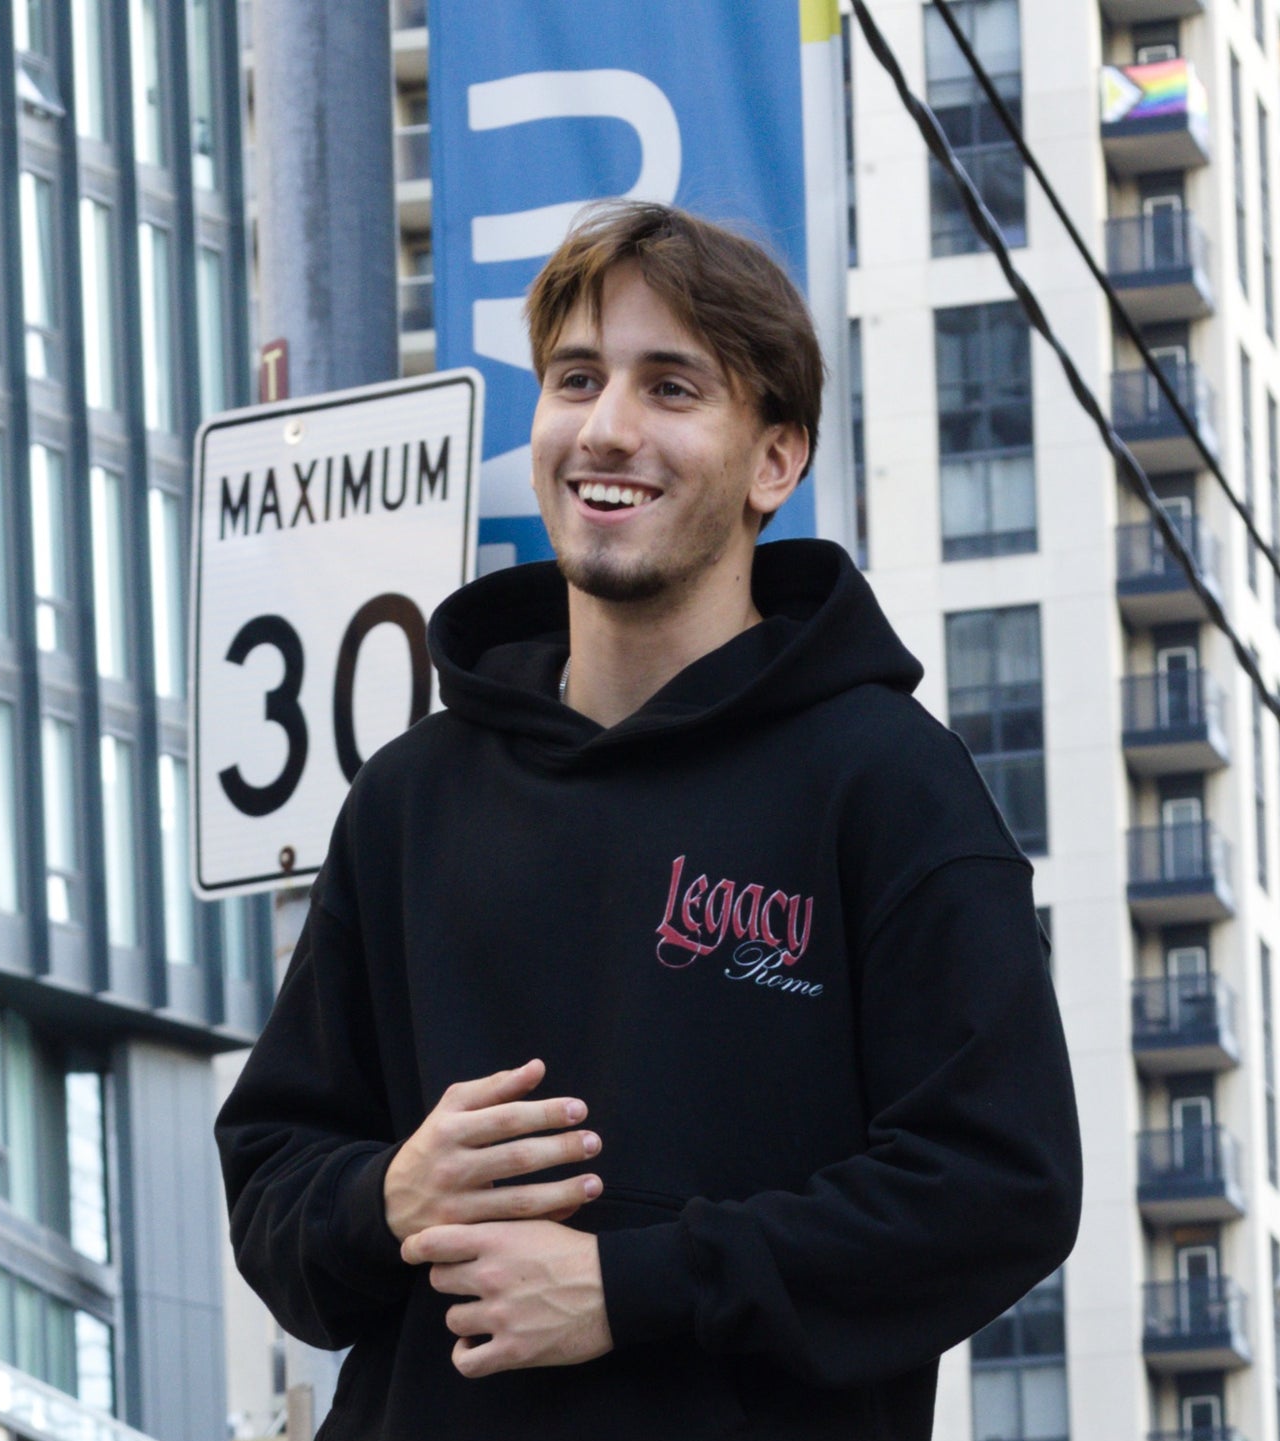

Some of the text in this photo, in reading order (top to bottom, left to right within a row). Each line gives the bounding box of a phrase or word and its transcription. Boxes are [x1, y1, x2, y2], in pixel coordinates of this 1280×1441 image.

[218, 434, 452, 542] MAXIMUM
[217, 592, 433, 819] 30
[723, 939, 824, 998] Rome
